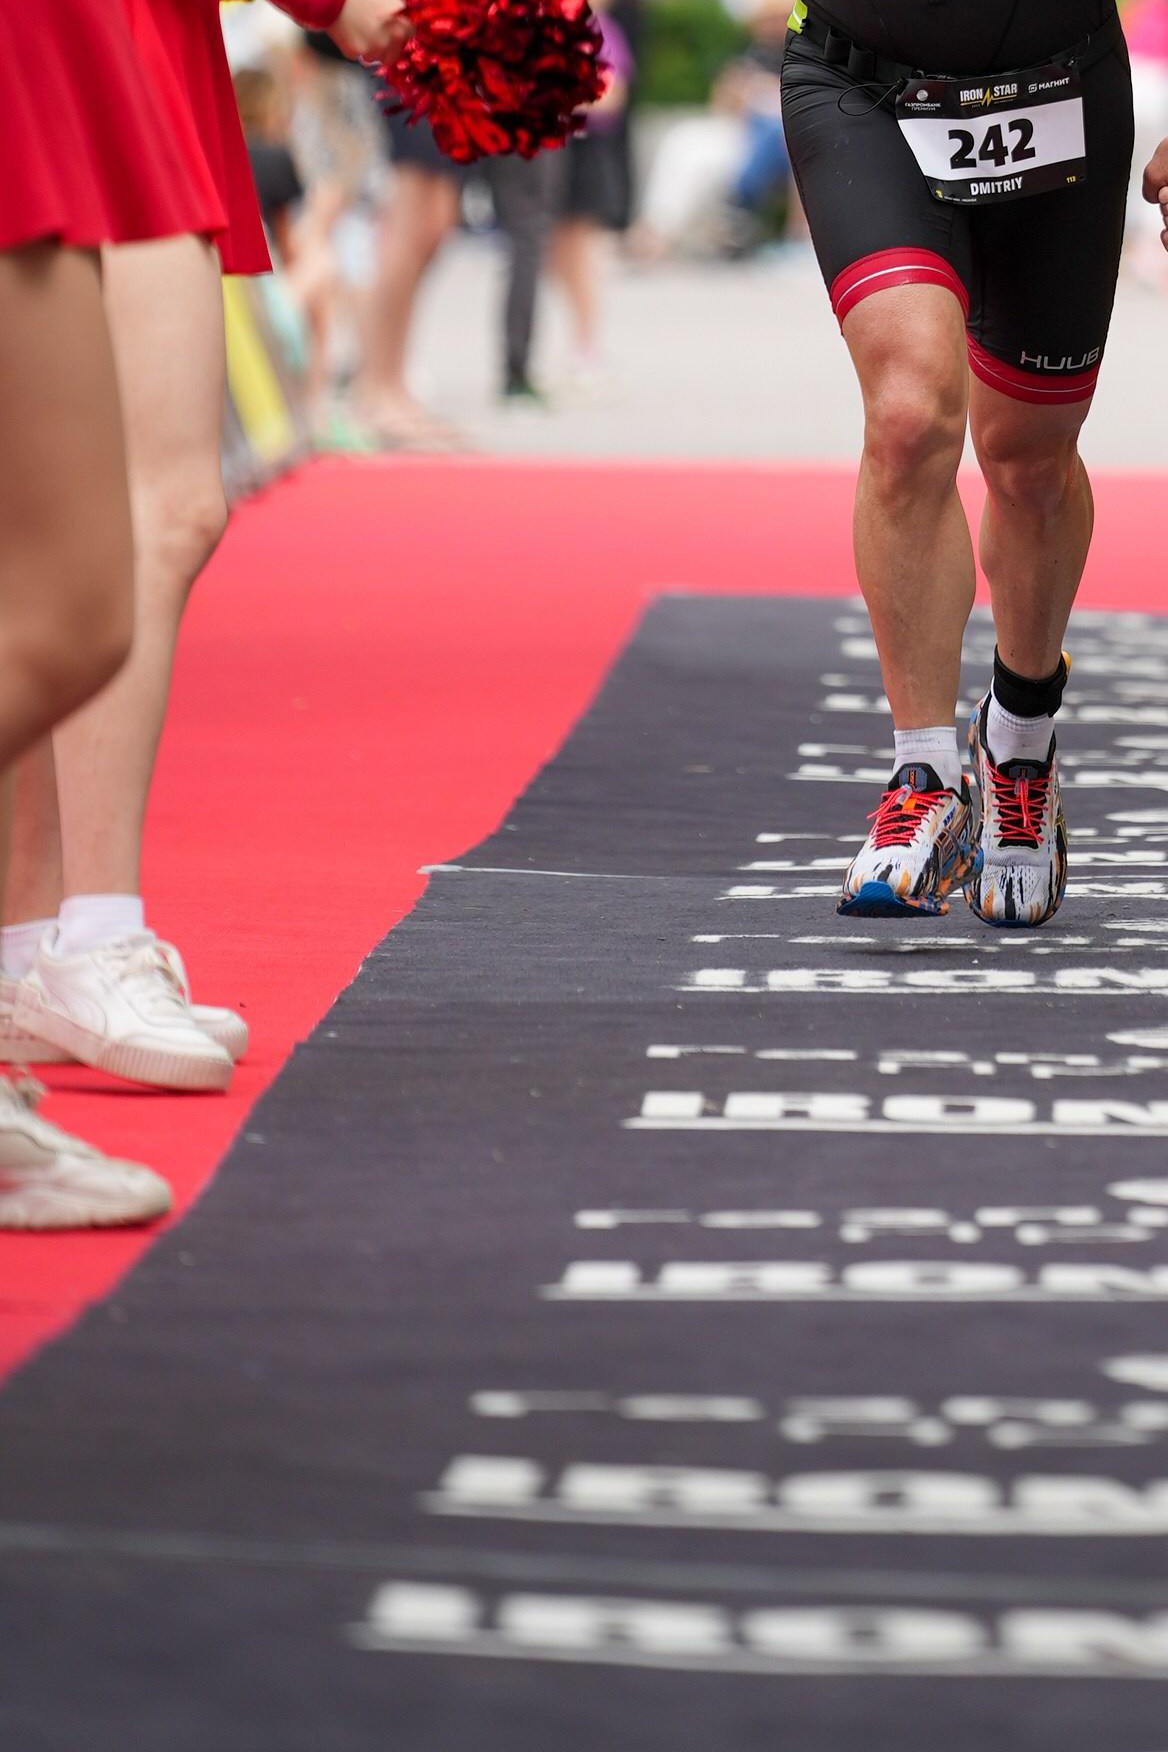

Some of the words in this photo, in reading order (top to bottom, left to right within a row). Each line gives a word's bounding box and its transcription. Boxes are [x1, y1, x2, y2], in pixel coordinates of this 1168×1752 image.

[959, 89, 983, 102] IRON
[993, 82, 1018, 97] STAR
[1037, 76, 1070, 90] МАГНИТ
[947, 118, 1036, 170] 242
[969, 176, 1023, 196] DMITRIY
[1019, 346, 1101, 371] HUUB
